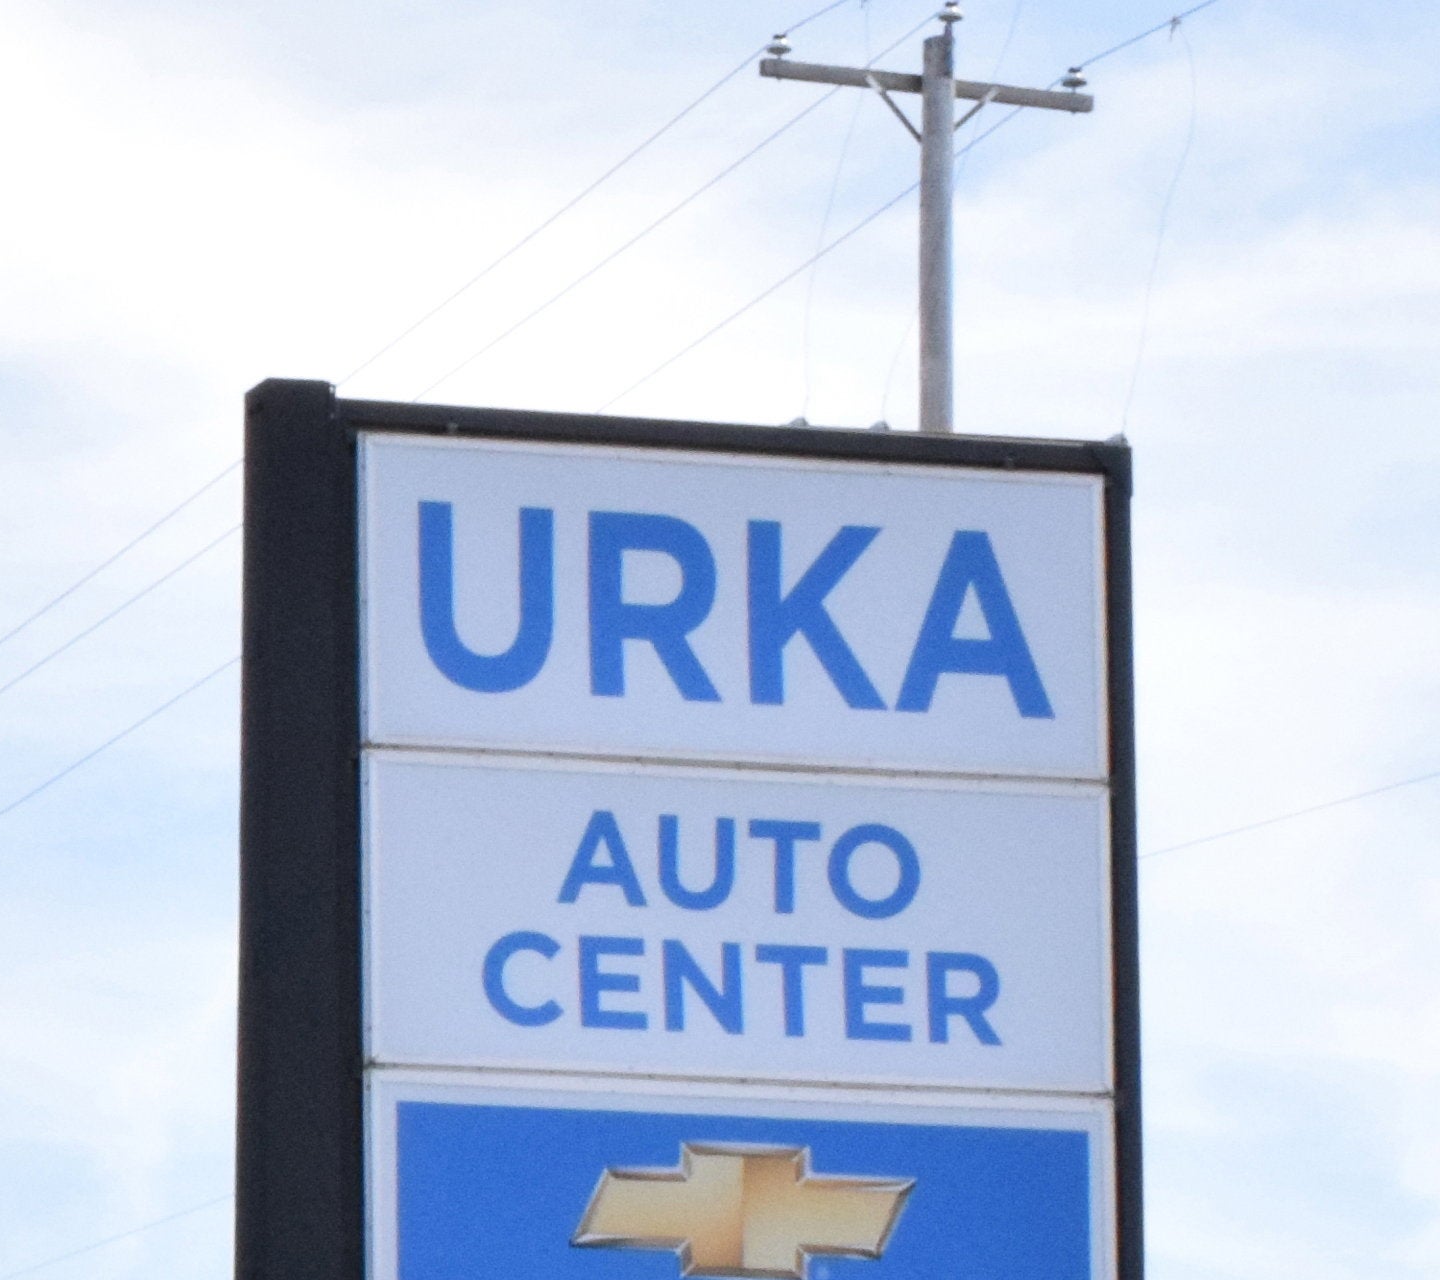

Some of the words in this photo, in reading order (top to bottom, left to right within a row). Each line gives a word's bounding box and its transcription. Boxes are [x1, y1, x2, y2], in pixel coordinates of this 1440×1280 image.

[418, 499, 1056, 720] URKA
[557, 809, 923, 921] AUTO
[482, 930, 1003, 1047] CENTER
